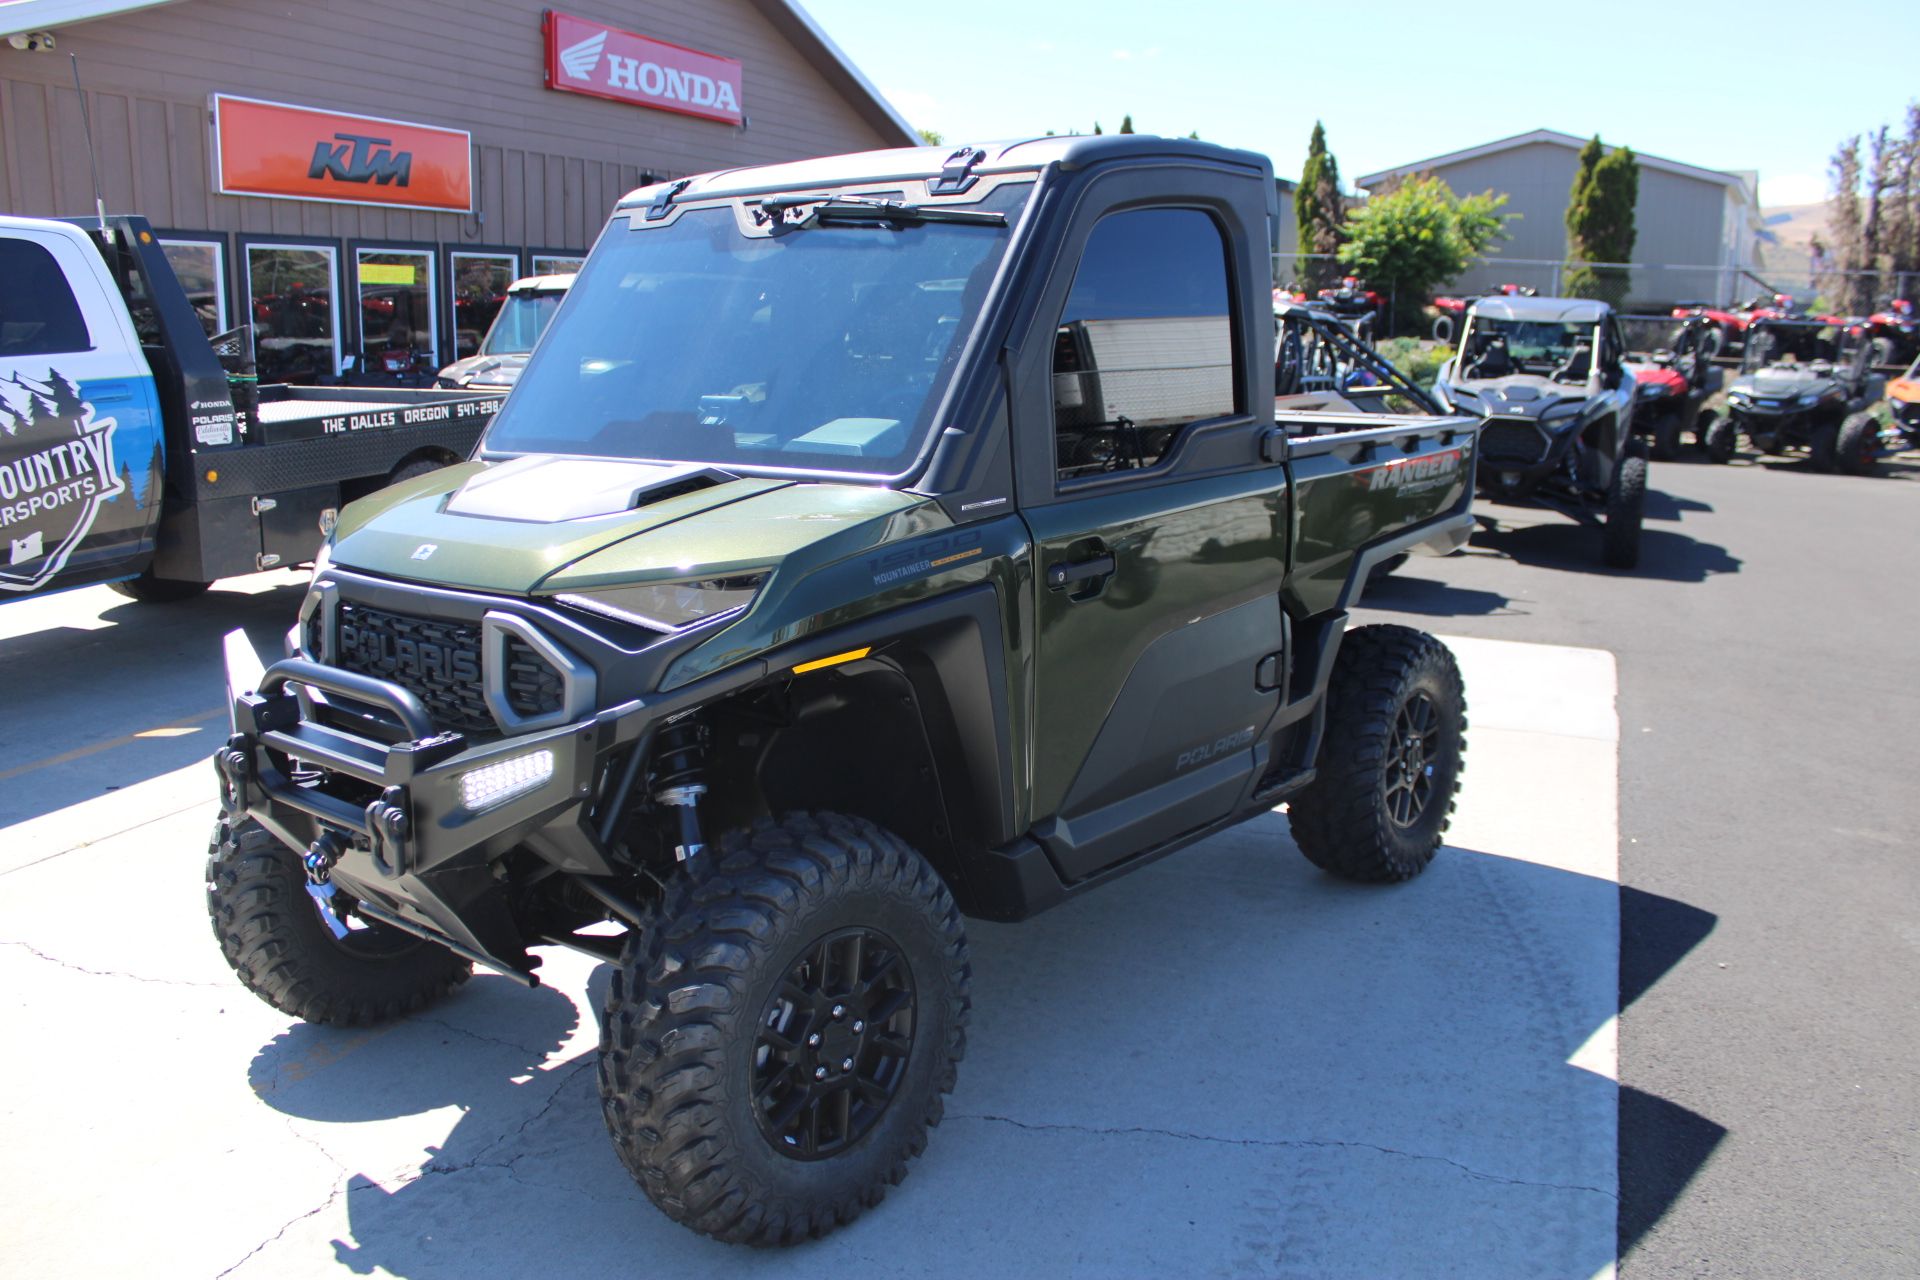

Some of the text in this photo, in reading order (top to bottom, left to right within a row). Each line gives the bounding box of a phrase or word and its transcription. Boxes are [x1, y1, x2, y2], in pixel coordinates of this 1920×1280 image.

[607, 53, 740, 112] HONDA
[307, 132, 412, 187] KTM
[192, 413, 234, 425] POLARIS
[200, 400, 231, 409] HONDA
[322, 418, 346, 433] THE
[350, 412, 395, 430] DALLES
[404, 406, 449, 424] OREGON
[1368, 454, 1459, 492] RANGER
[873, 559, 932, 585] MOUNTAINEER
[341, 624, 480, 683] POLARIS
[1176, 725, 1256, 771] POLARIS
